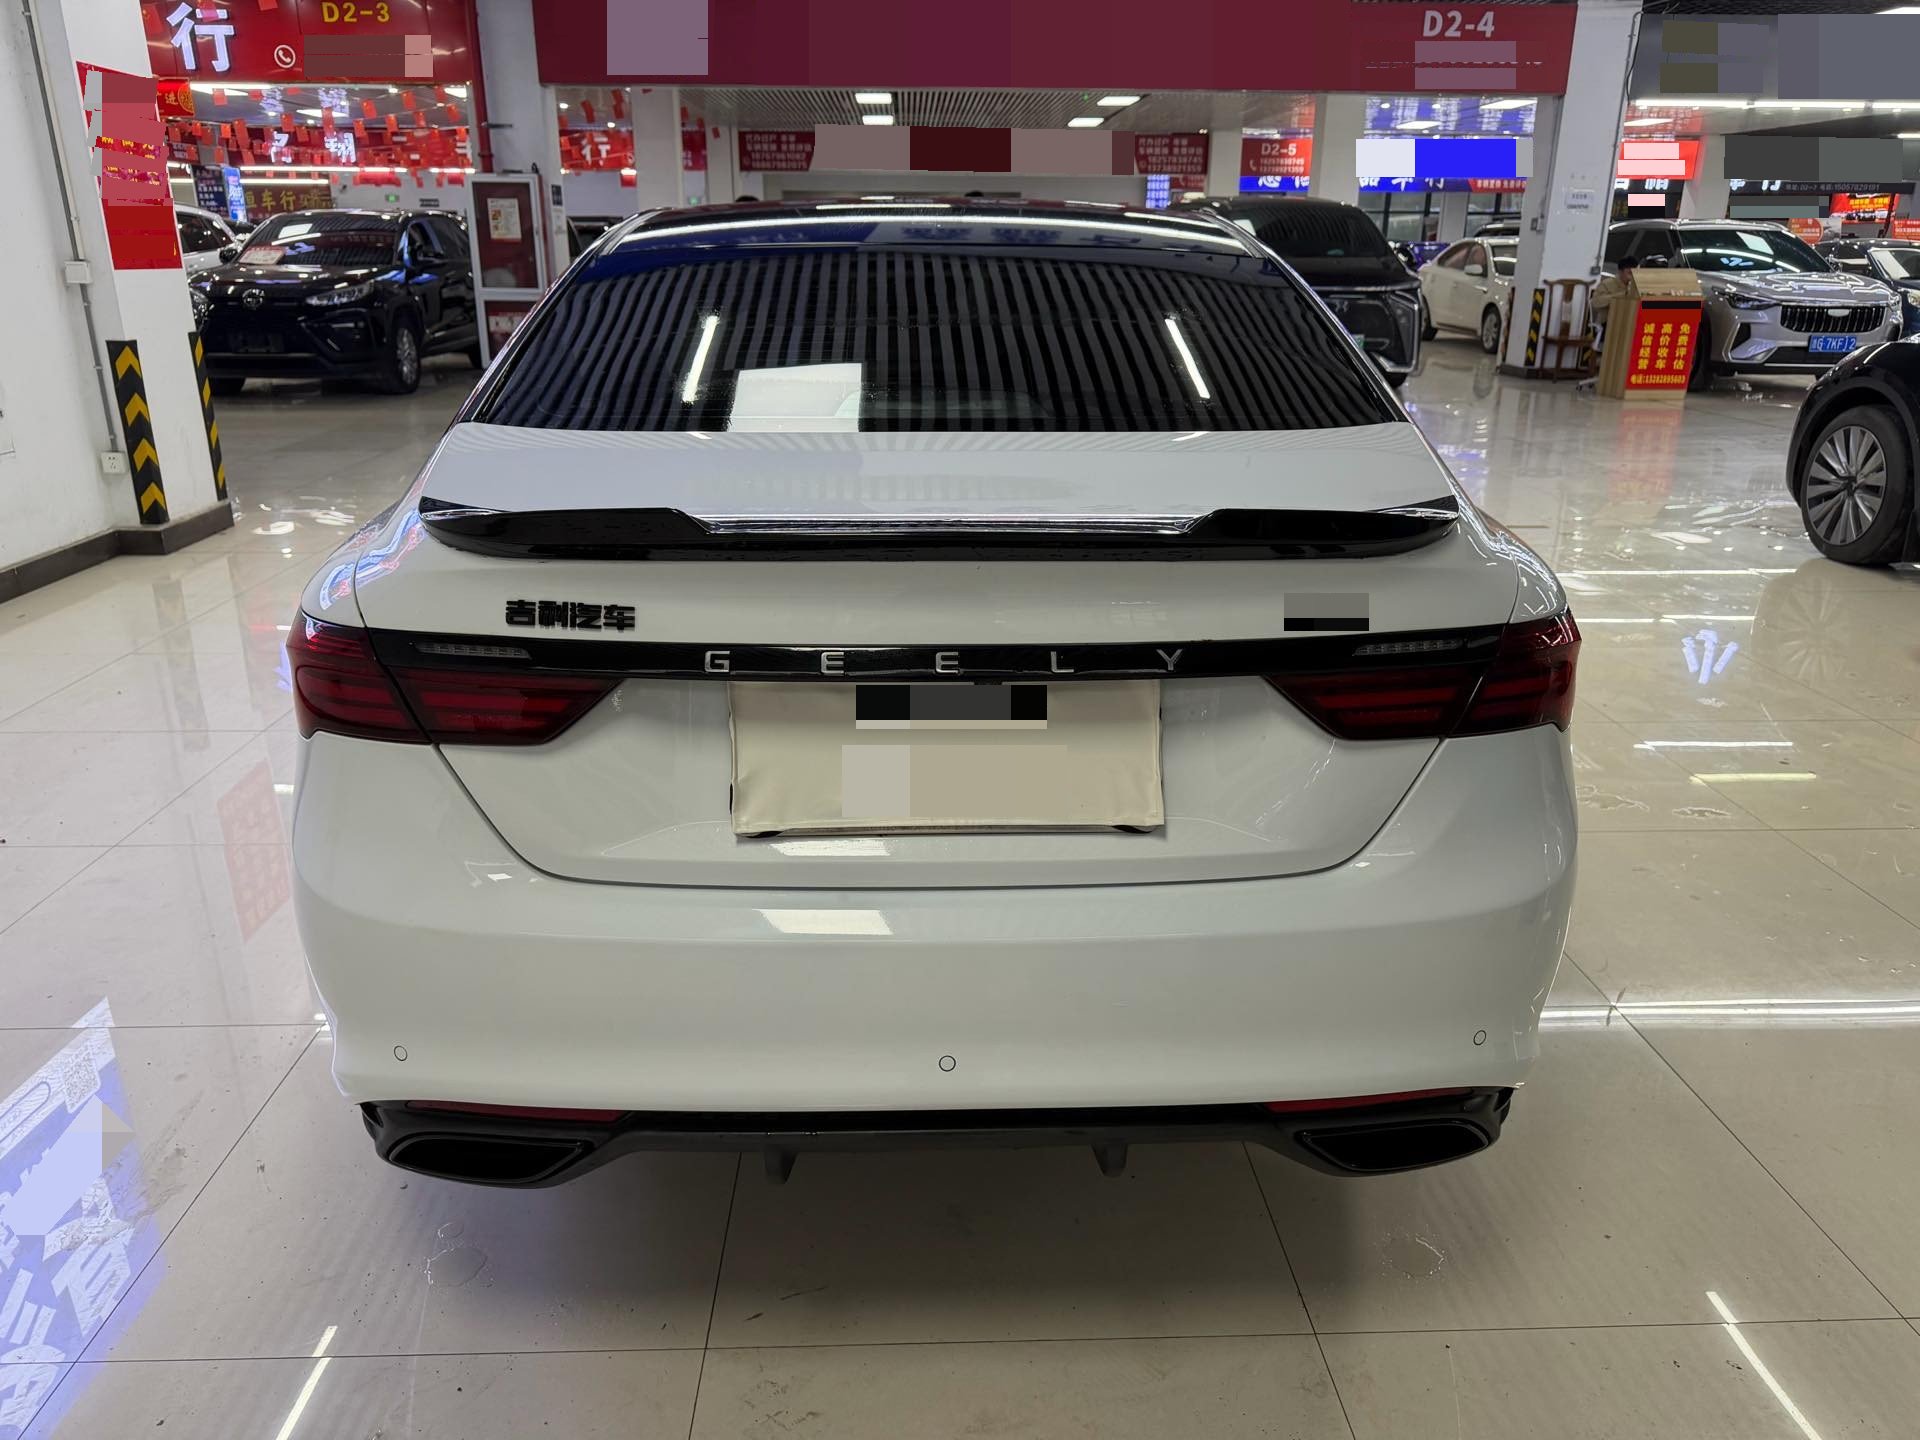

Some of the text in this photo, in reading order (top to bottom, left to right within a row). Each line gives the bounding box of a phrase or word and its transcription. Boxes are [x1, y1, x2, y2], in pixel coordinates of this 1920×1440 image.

[322, 1, 391, 23] D2-3
[1422, 10, 1496, 38] D2-4
[166, 2, 235, 73] 行
[1261, 143, 1297, 156] D2-5
[1637, 322, 1656, 370] 诚信经营
[1654, 322, 1673, 370] 高价收车
[1673, 322, 1691, 370] 免费评估
[506, 600, 636, 632] 吉利汽车
[704, 647, 1185, 676] GEELY
